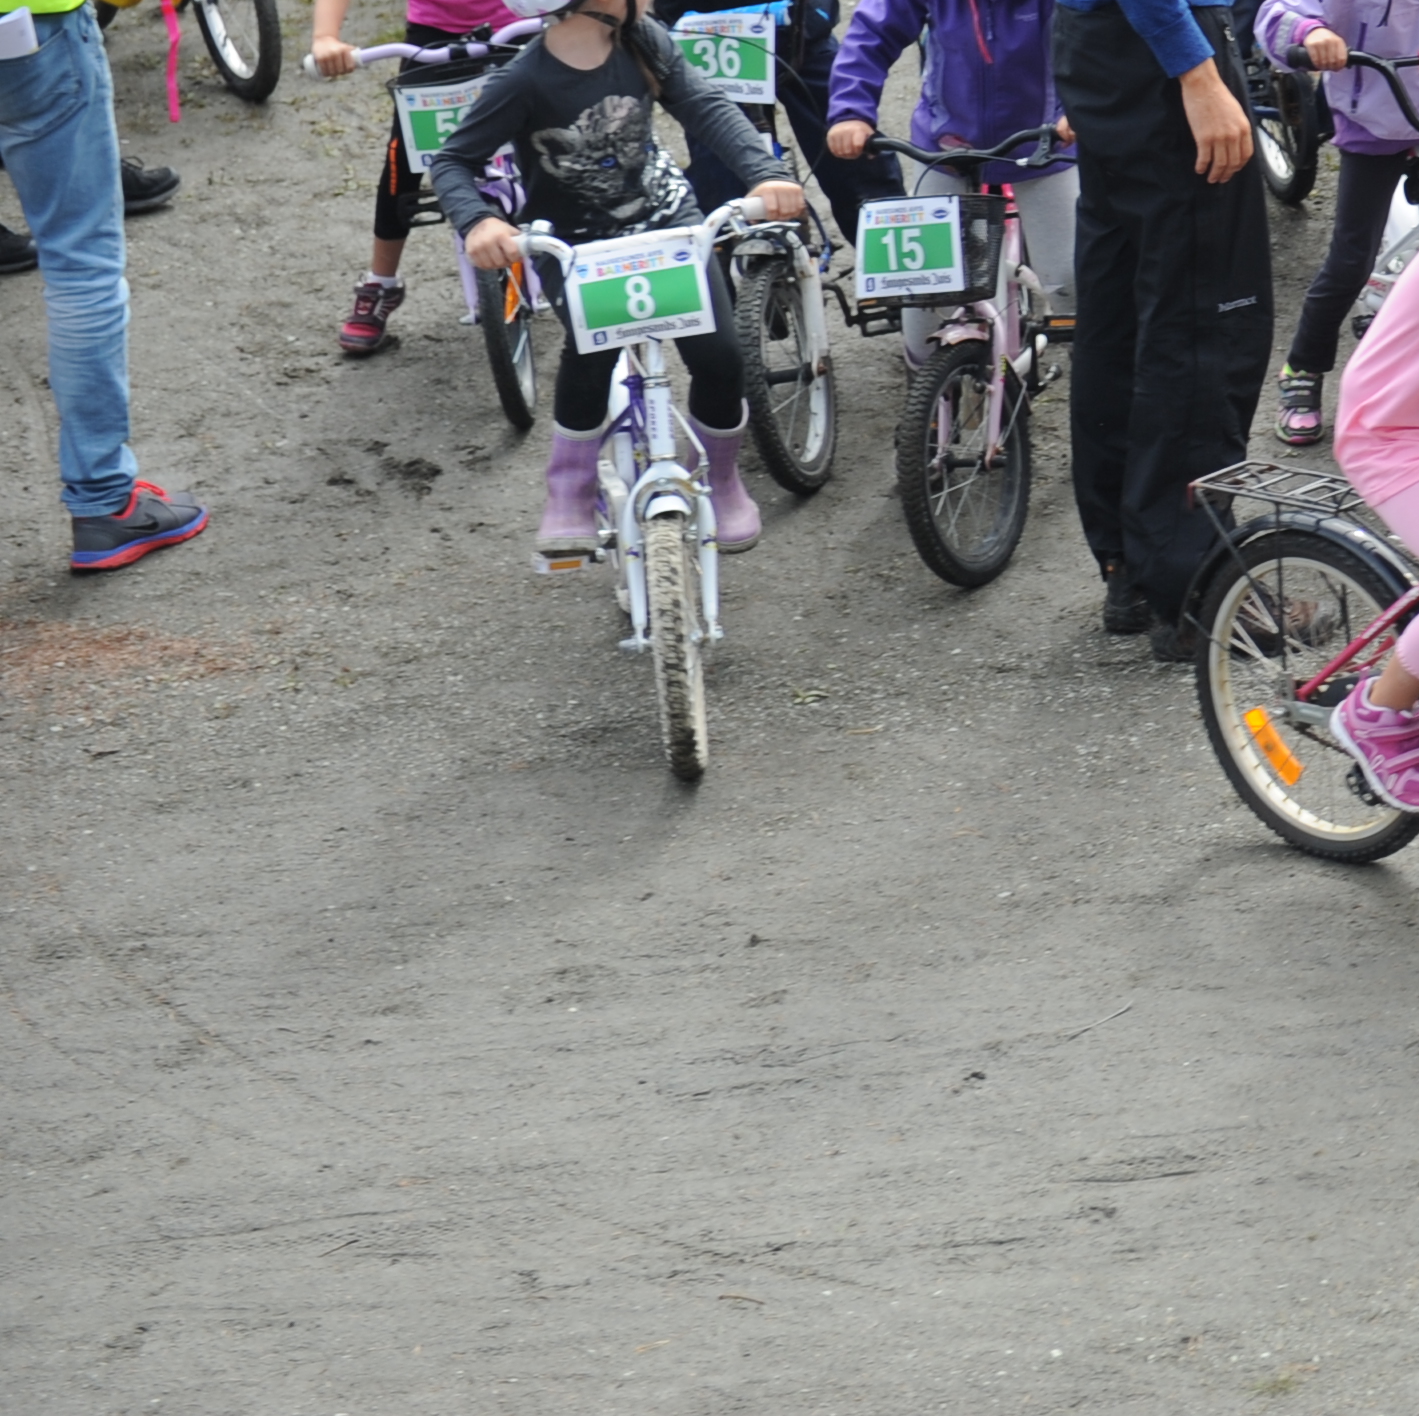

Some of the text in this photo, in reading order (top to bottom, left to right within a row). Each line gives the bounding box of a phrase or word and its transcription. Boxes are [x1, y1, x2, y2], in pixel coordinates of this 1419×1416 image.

[693, 37, 742, 77] 36
[435, 105, 471, 144] 5
[596, 256, 665, 277] BARNERITT
[881, 228, 926, 271] 15
[625, 275, 656, 320] 8
